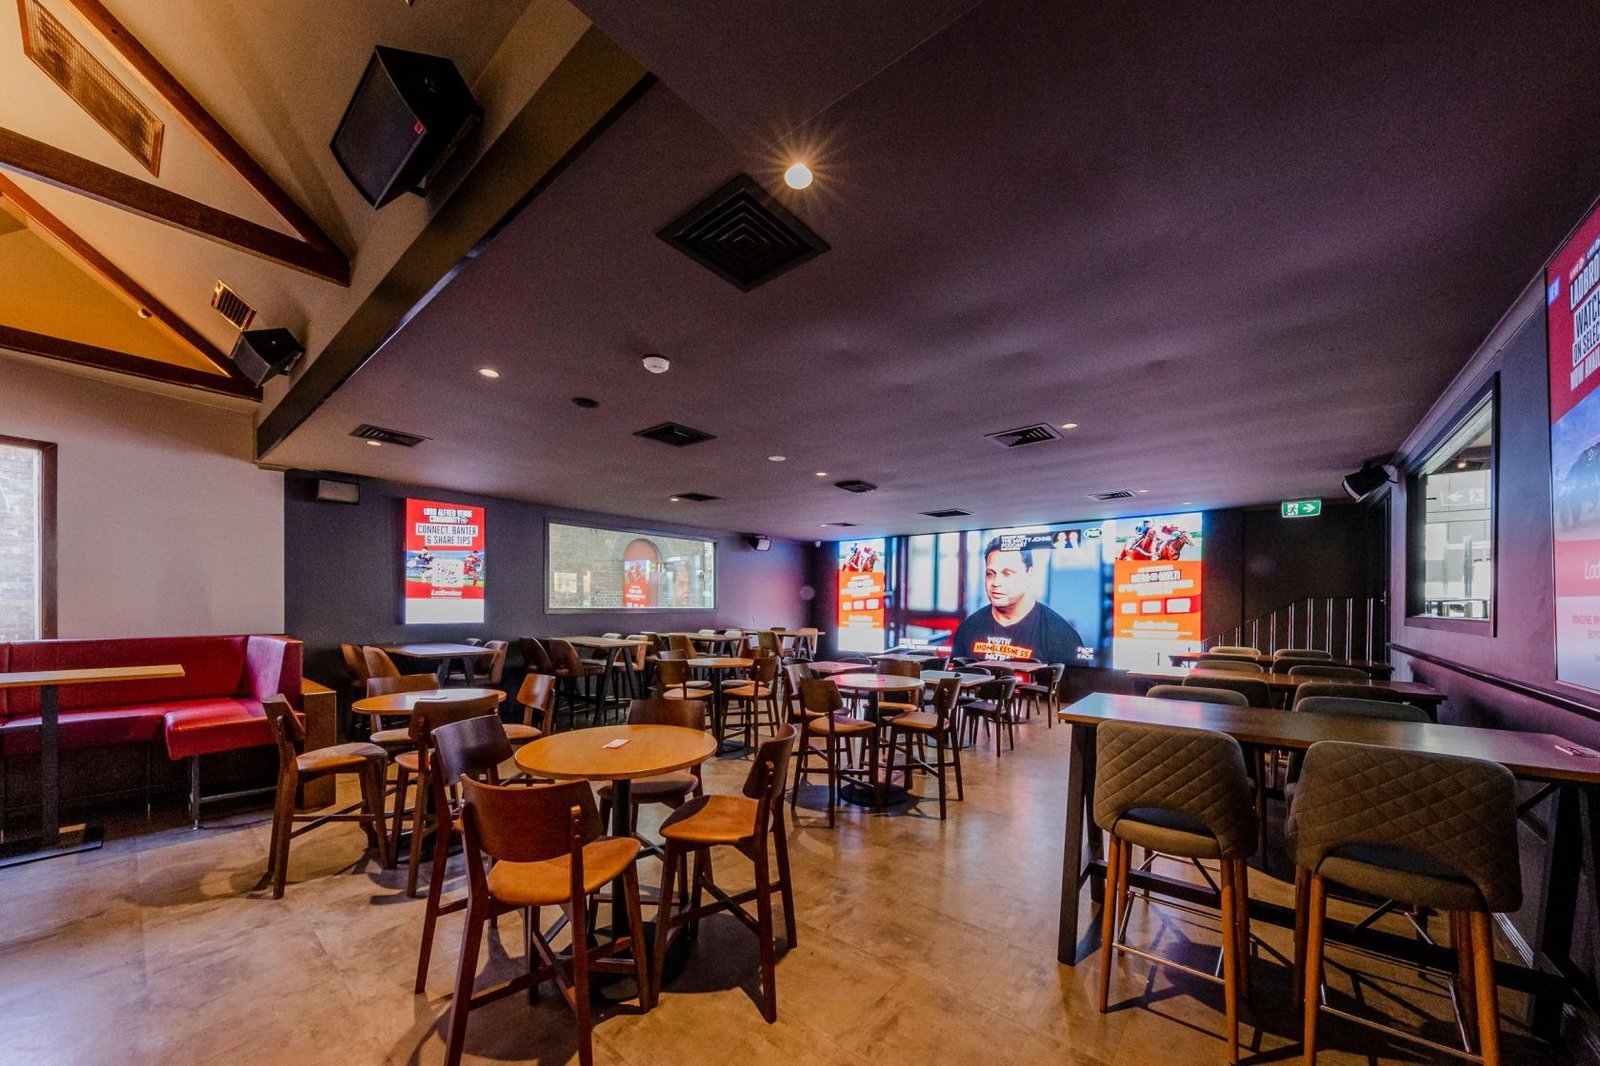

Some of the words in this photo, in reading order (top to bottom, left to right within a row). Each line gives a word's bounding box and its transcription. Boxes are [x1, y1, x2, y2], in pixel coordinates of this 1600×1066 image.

[1574, 339, 1582, 363] ON
[452, 526, 477, 535] BANTER
[434, 535, 454, 544] SHARE
[457, 536, 471, 545] TIPS
[987, 636, 1012, 645] YOUTH
[976, 643, 1029, 658] HOMELESSNESS
